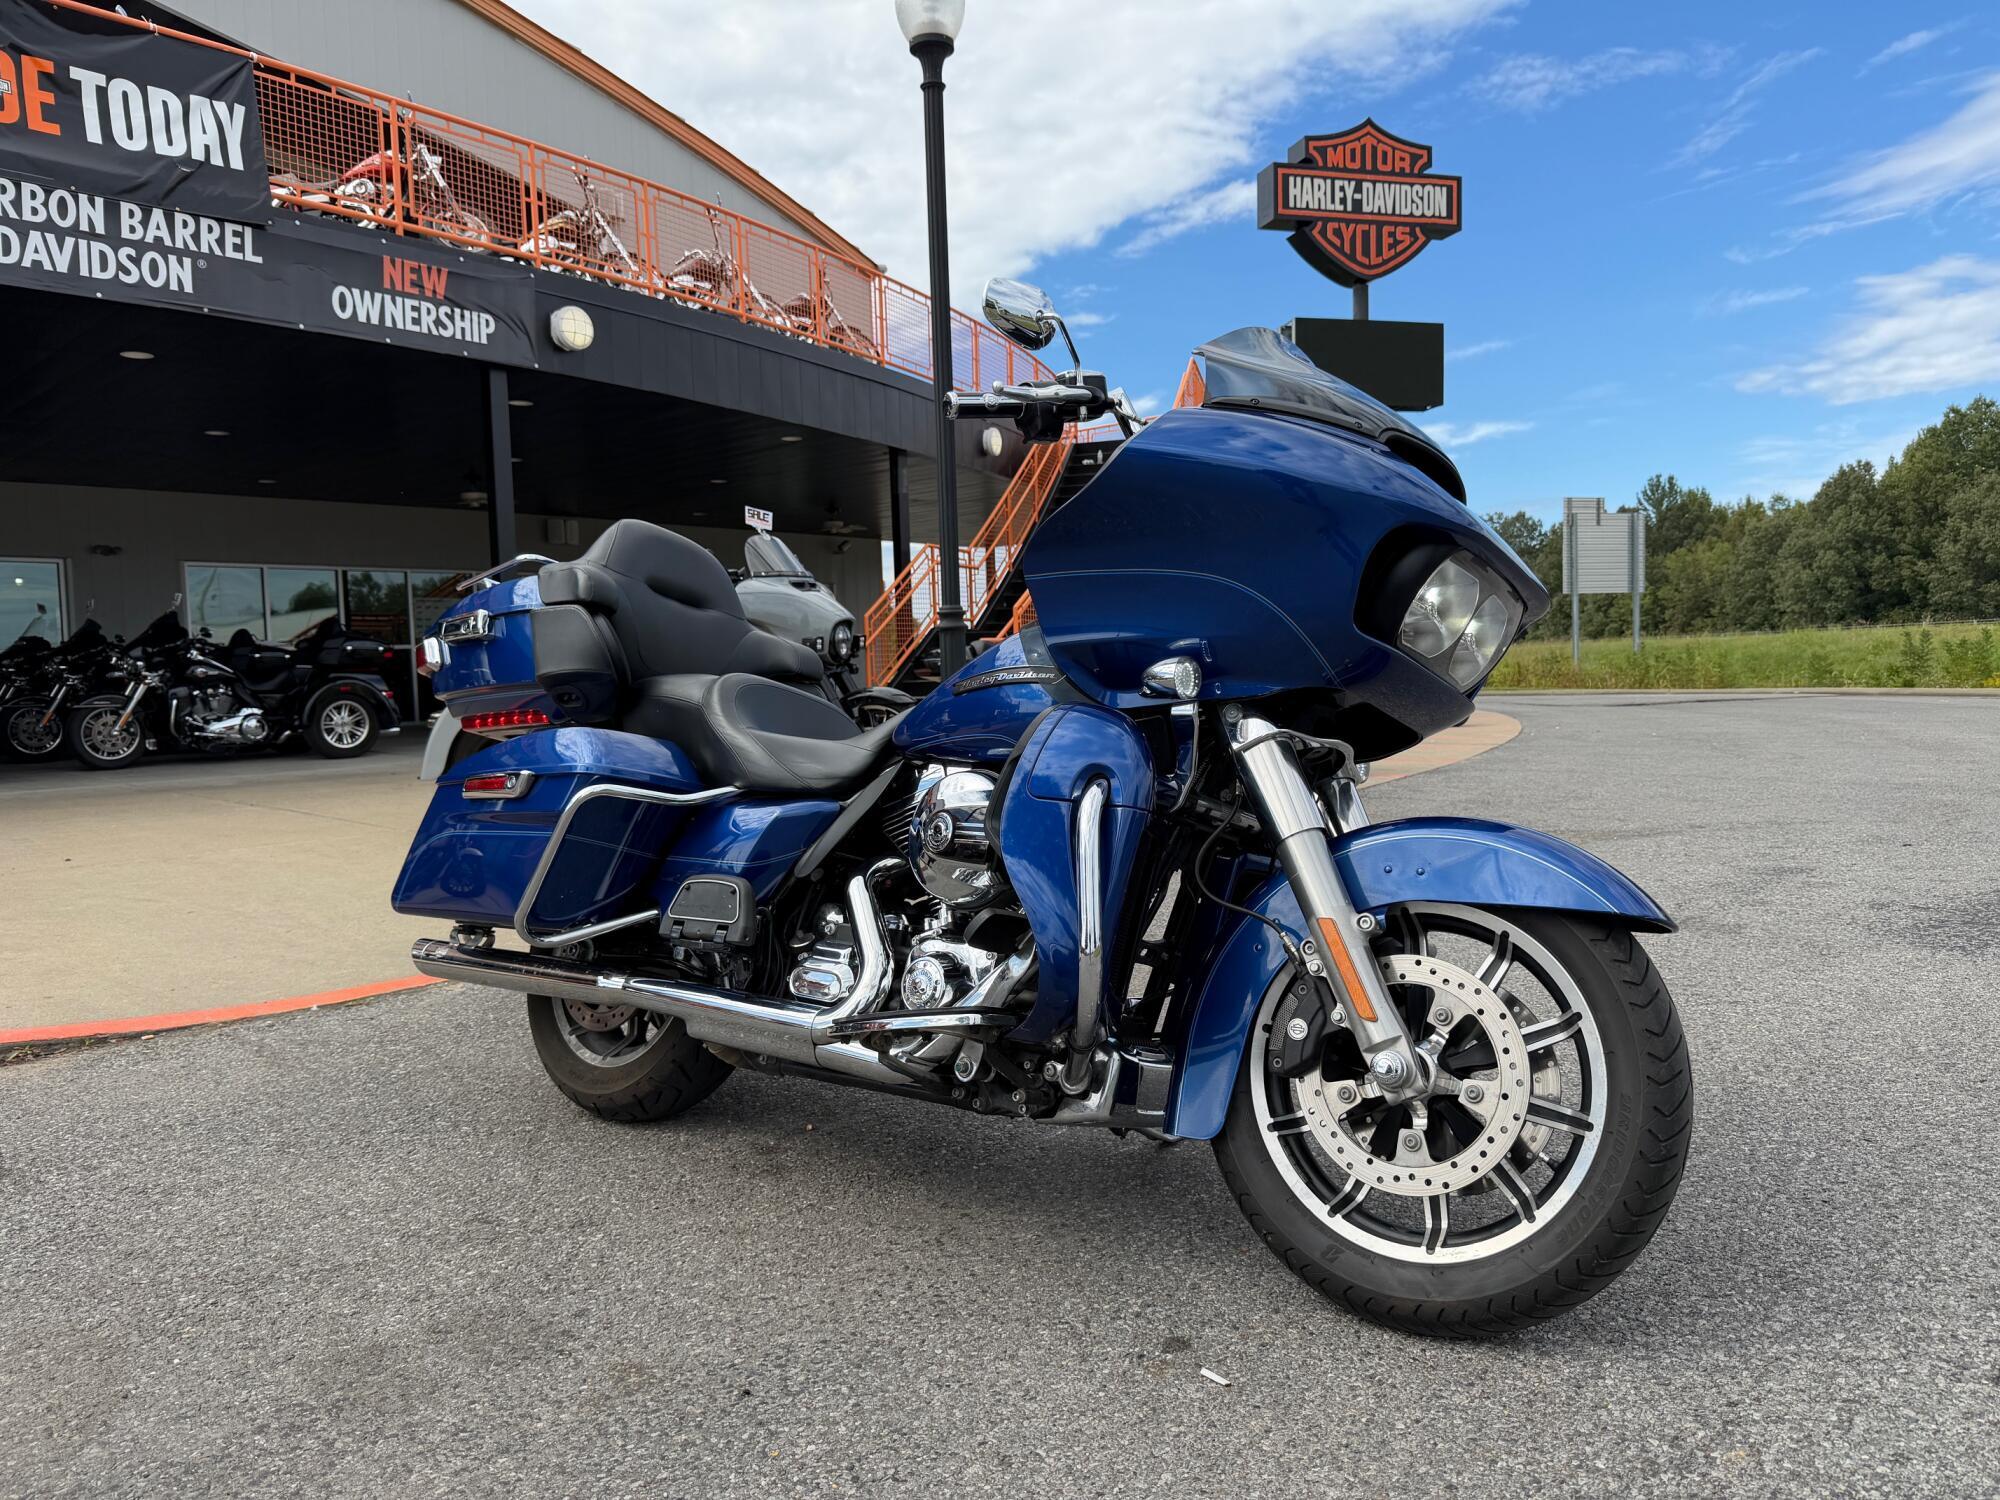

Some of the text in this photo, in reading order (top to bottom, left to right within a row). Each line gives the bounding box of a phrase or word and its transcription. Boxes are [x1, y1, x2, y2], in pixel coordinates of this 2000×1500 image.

[69, 66, 246, 171] TODAY
[1327, 135, 1411, 173] MOTOR
[1288, 175, 1448, 218] HARLEY-DAVIDSON
[0, 177, 264, 264] RBON BARREL
[1327, 221, 1411, 265] CYCLES
[382, 255, 449, 300] NEW
[331, 285, 496, 345] OWNERSHIP
[747, 508, 770, 524] SALE
